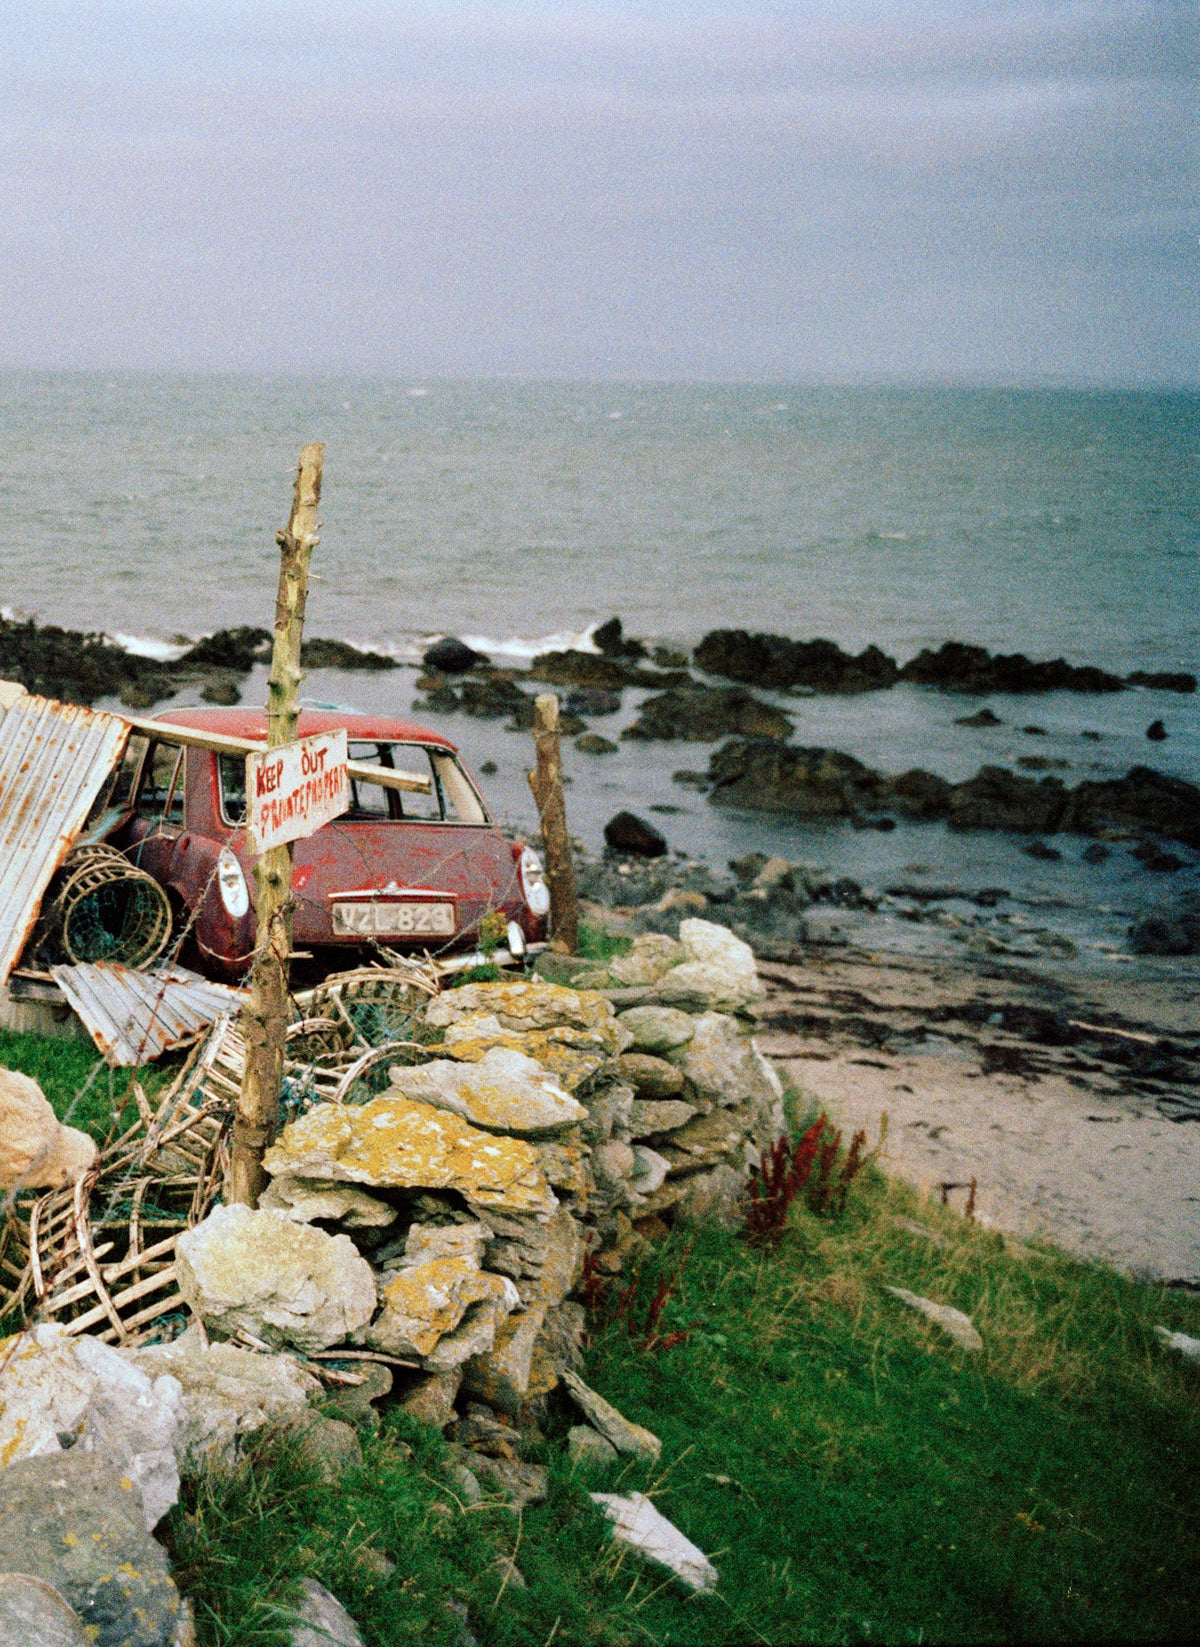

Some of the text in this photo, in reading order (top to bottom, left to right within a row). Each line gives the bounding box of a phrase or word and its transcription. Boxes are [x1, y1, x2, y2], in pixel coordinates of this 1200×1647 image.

[256, 747, 328, 798] KEEP OUT
[261, 784, 305, 839] PRIVATE
[341, 905, 390, 932] VZL
